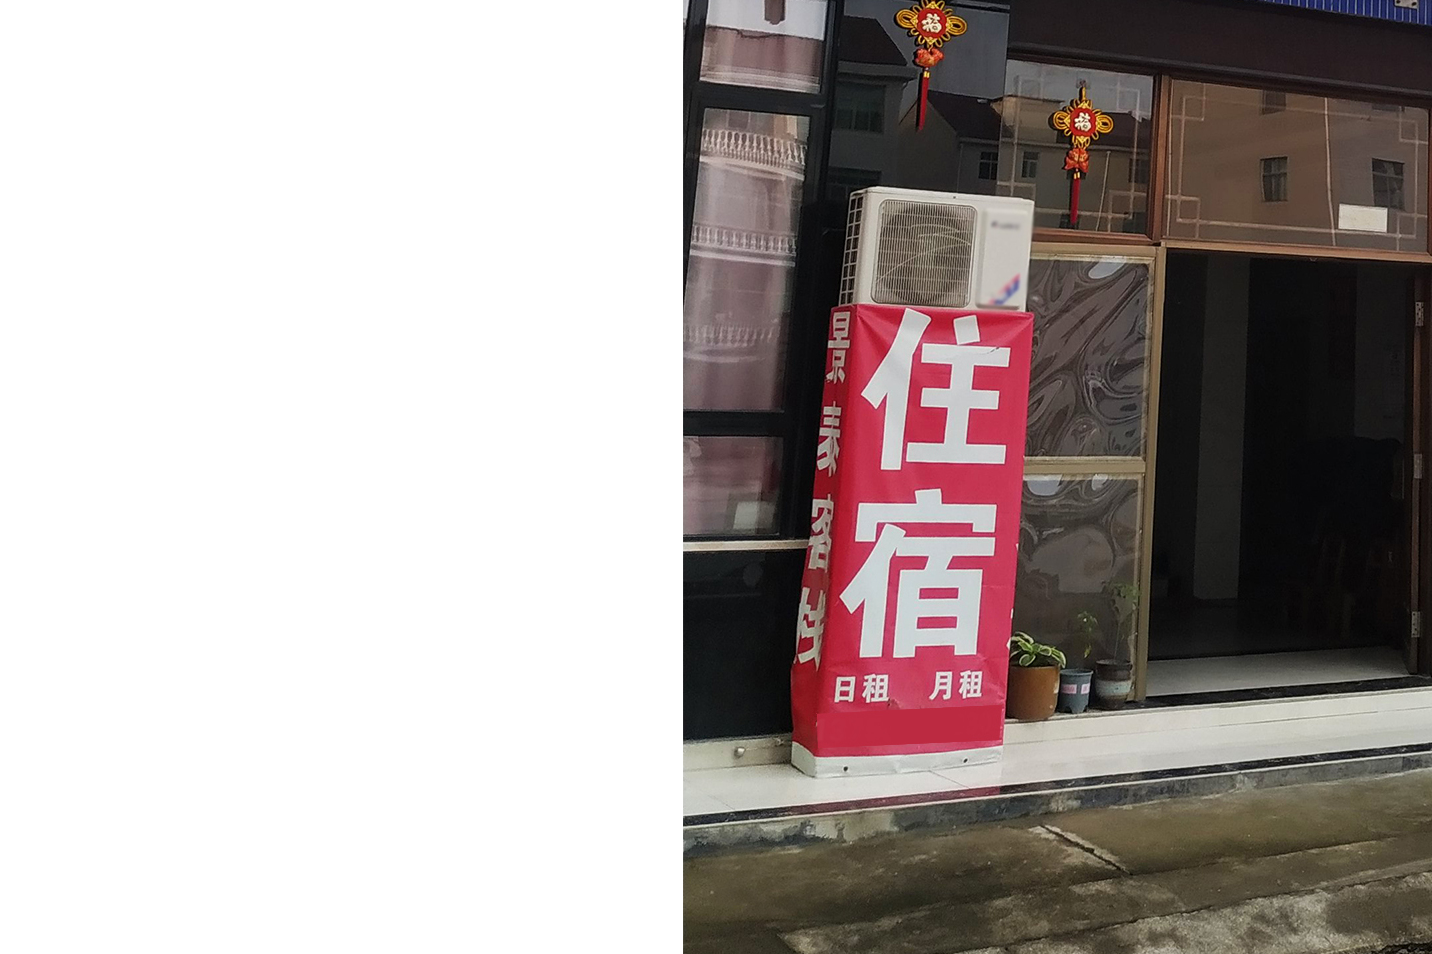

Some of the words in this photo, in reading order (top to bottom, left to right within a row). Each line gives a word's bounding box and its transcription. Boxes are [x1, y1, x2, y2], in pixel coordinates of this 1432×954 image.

[920, 13, 943, 33] 福
[1074, 112, 1092, 131] 福
[839, 307, 1011, 660] 住宿
[833, 673, 890, 703] 日租
[929, 669, 983, 701] 月租
